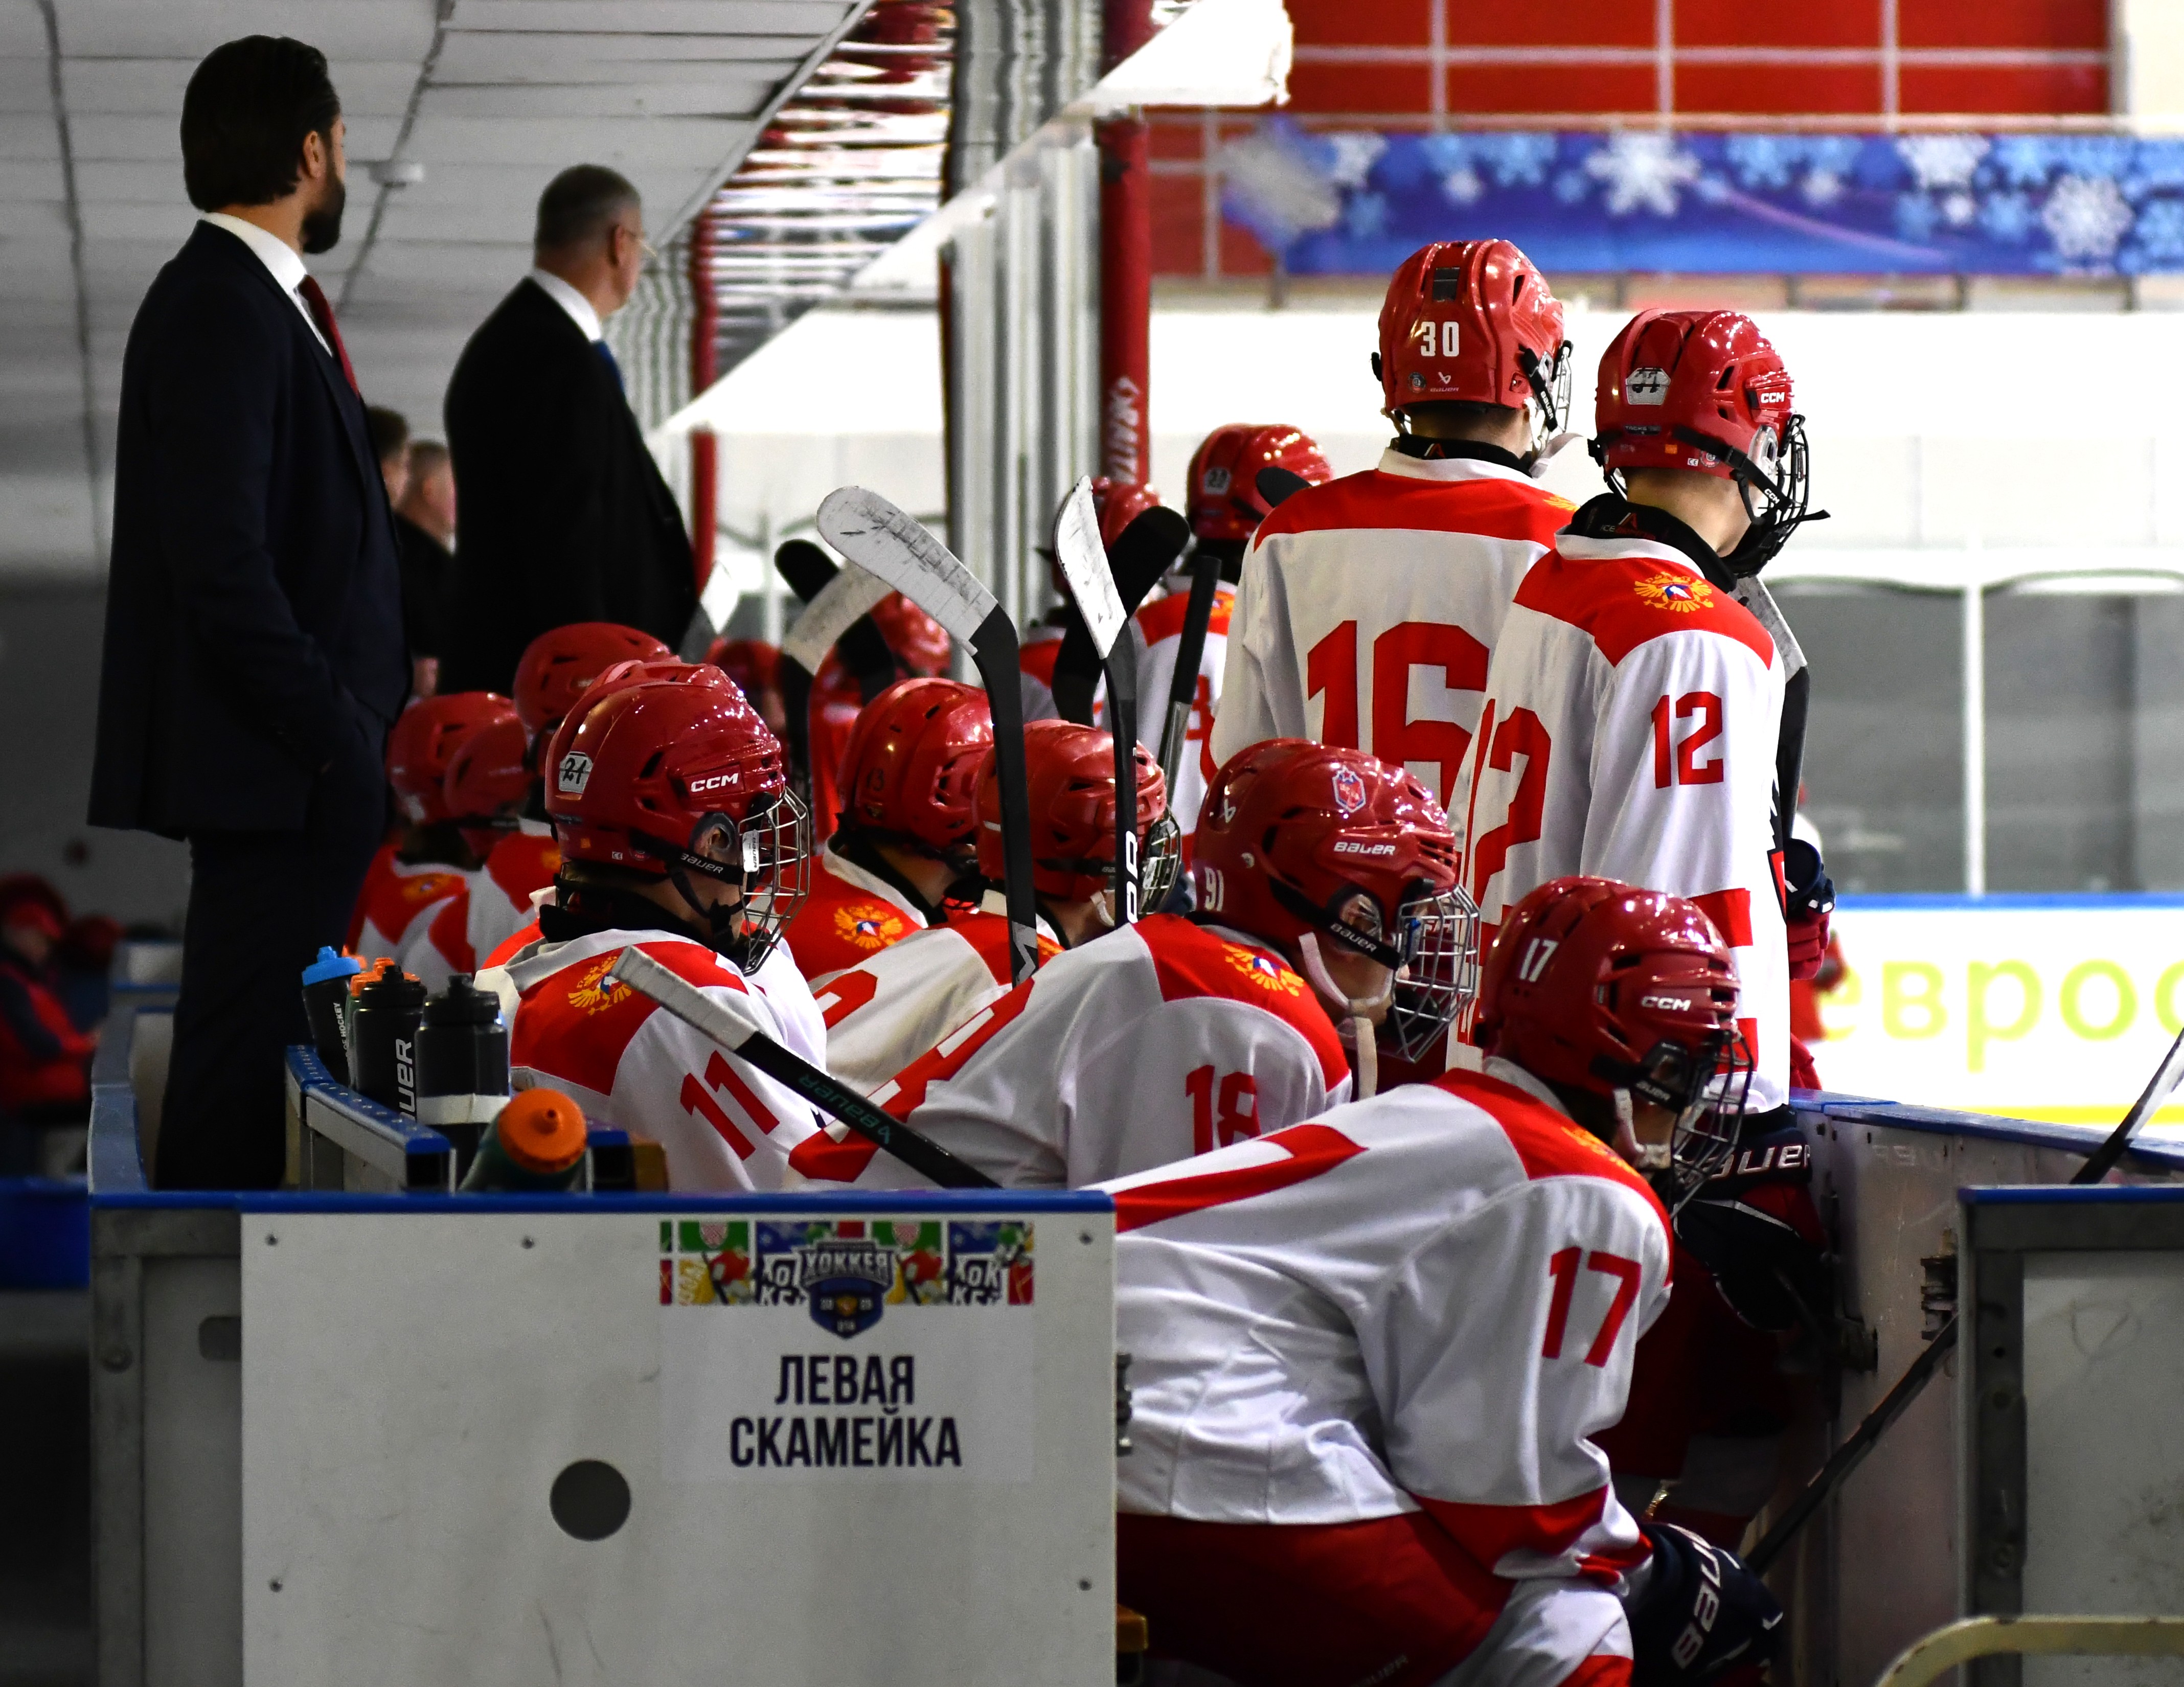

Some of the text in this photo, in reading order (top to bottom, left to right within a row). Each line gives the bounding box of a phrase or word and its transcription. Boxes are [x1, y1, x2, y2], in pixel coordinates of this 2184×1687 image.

[1421, 321, 1460, 357] 30
[1540, 391, 1554, 421] BAUER
[1761, 392, 1785, 403] CCM
[1764, 488, 1780, 504] CCM
[1651, 691, 1724, 789] 12
[691, 772, 739, 793] CCM
[1334, 841, 1396, 856] BAUER
[1204, 867, 1224, 912] 91
[1330, 923, 1378, 953] BAUER
[1519, 938, 1559, 982] 17
[333, 1001, 347, 1039] HOCKEY
[1641, 995, 1692, 1012] CCM
[679, 1050, 781, 1160] 11
[798, 1075, 880, 1128] BAUER
[1185, 1064, 1263, 1157] 18
[1542, 1246, 1643, 1368] 17
[775, 1355, 915, 1406] ЛЕВАЯ
[730, 1406, 962, 1468] СКАМЕЙКА
